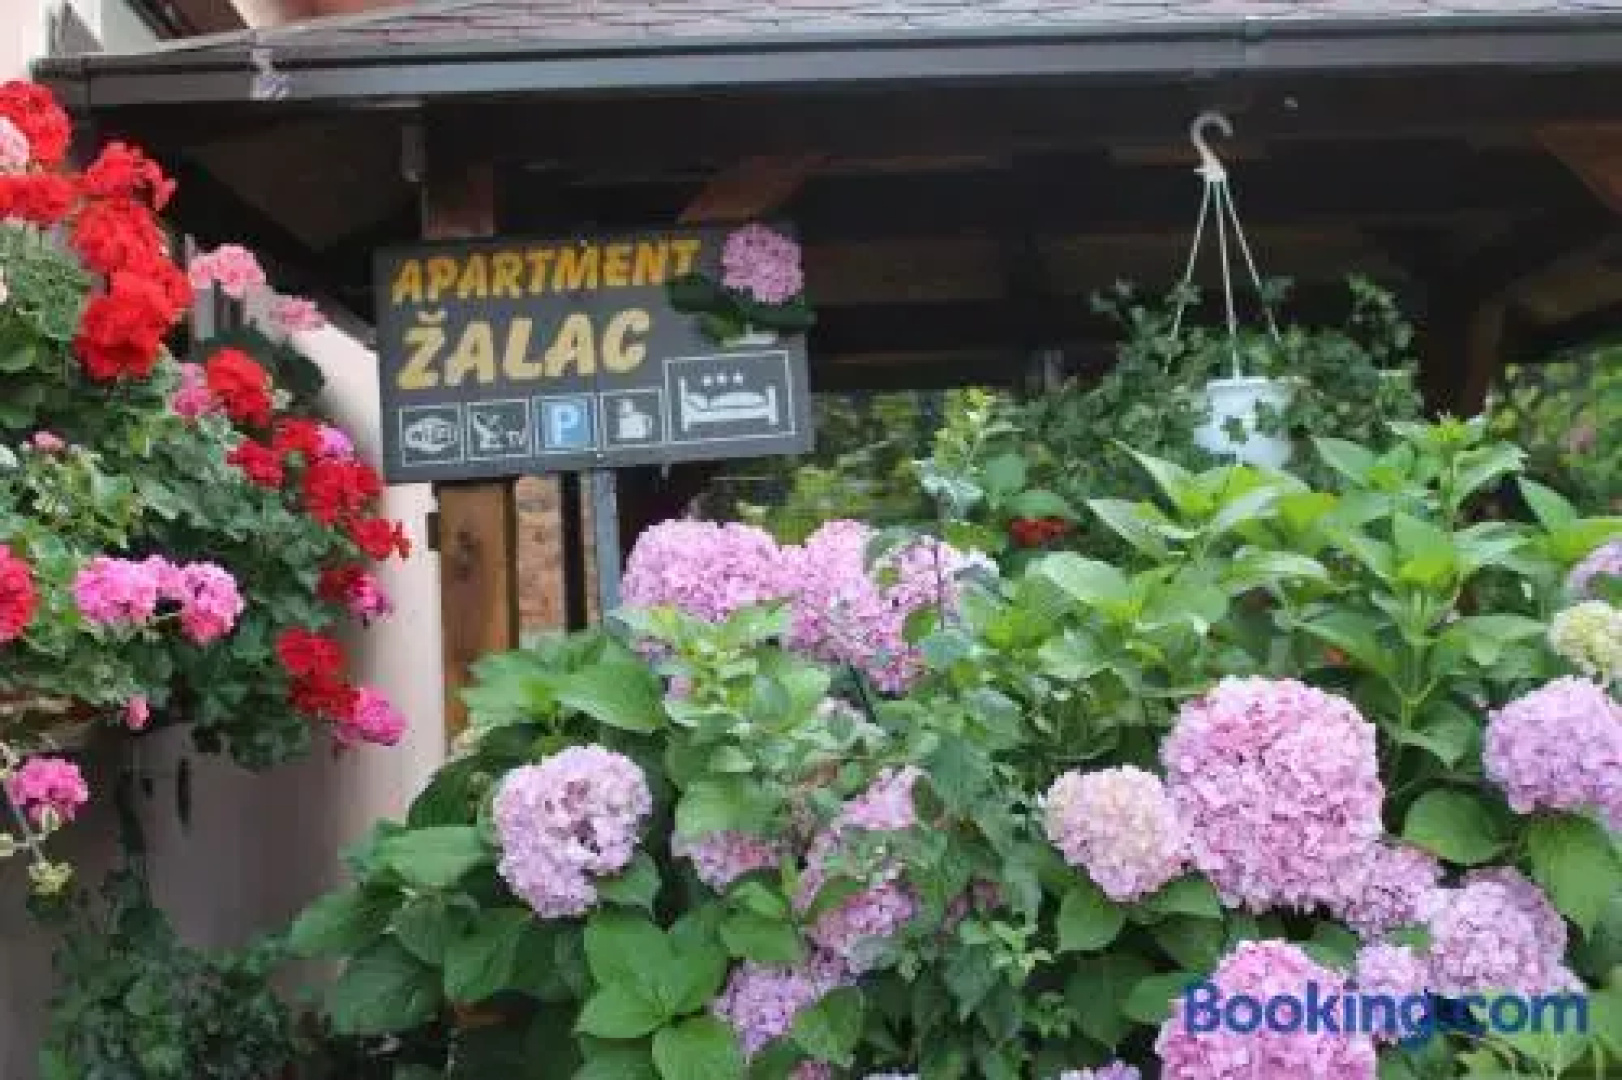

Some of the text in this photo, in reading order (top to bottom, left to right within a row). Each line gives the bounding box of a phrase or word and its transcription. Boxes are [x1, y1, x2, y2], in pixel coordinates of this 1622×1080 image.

[392, 239, 702, 303] APARTMENT
[396, 309, 652, 389] ŽALAC
[552, 404, 580, 446] P
